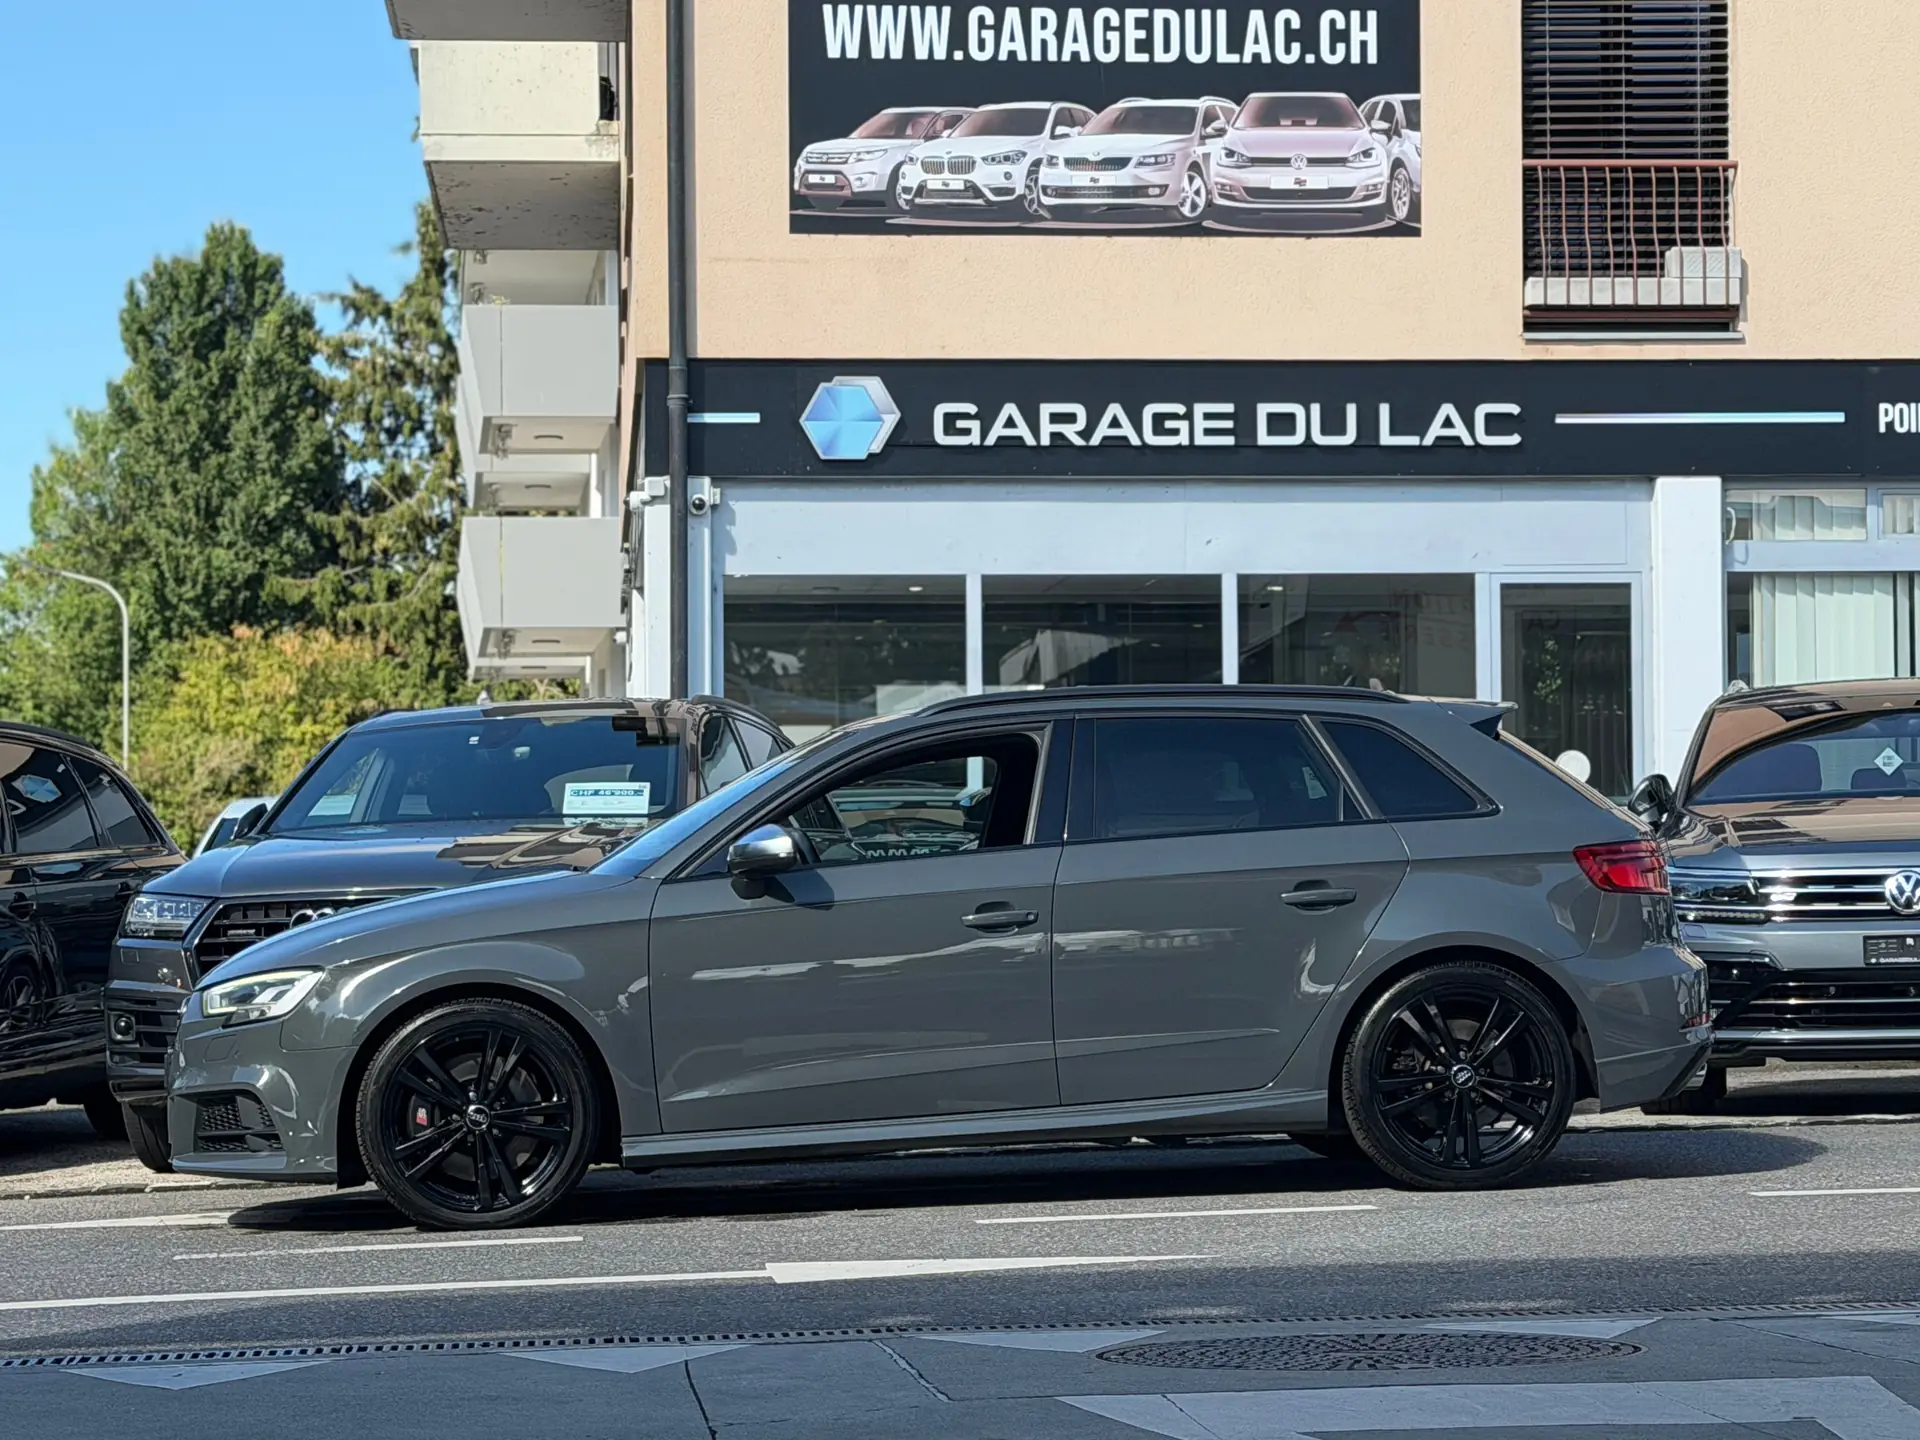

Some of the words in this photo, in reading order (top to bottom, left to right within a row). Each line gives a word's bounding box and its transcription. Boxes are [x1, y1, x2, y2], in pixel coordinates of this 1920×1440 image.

[822, 3, 1379, 65] WWW.GARAGEDULAC.CH
[933, 402, 1235, 446] GARAGE
[1256, 402, 1357, 446] DU
[1379, 402, 1522, 446] LAC
[1878, 402, 1920, 433] POI
